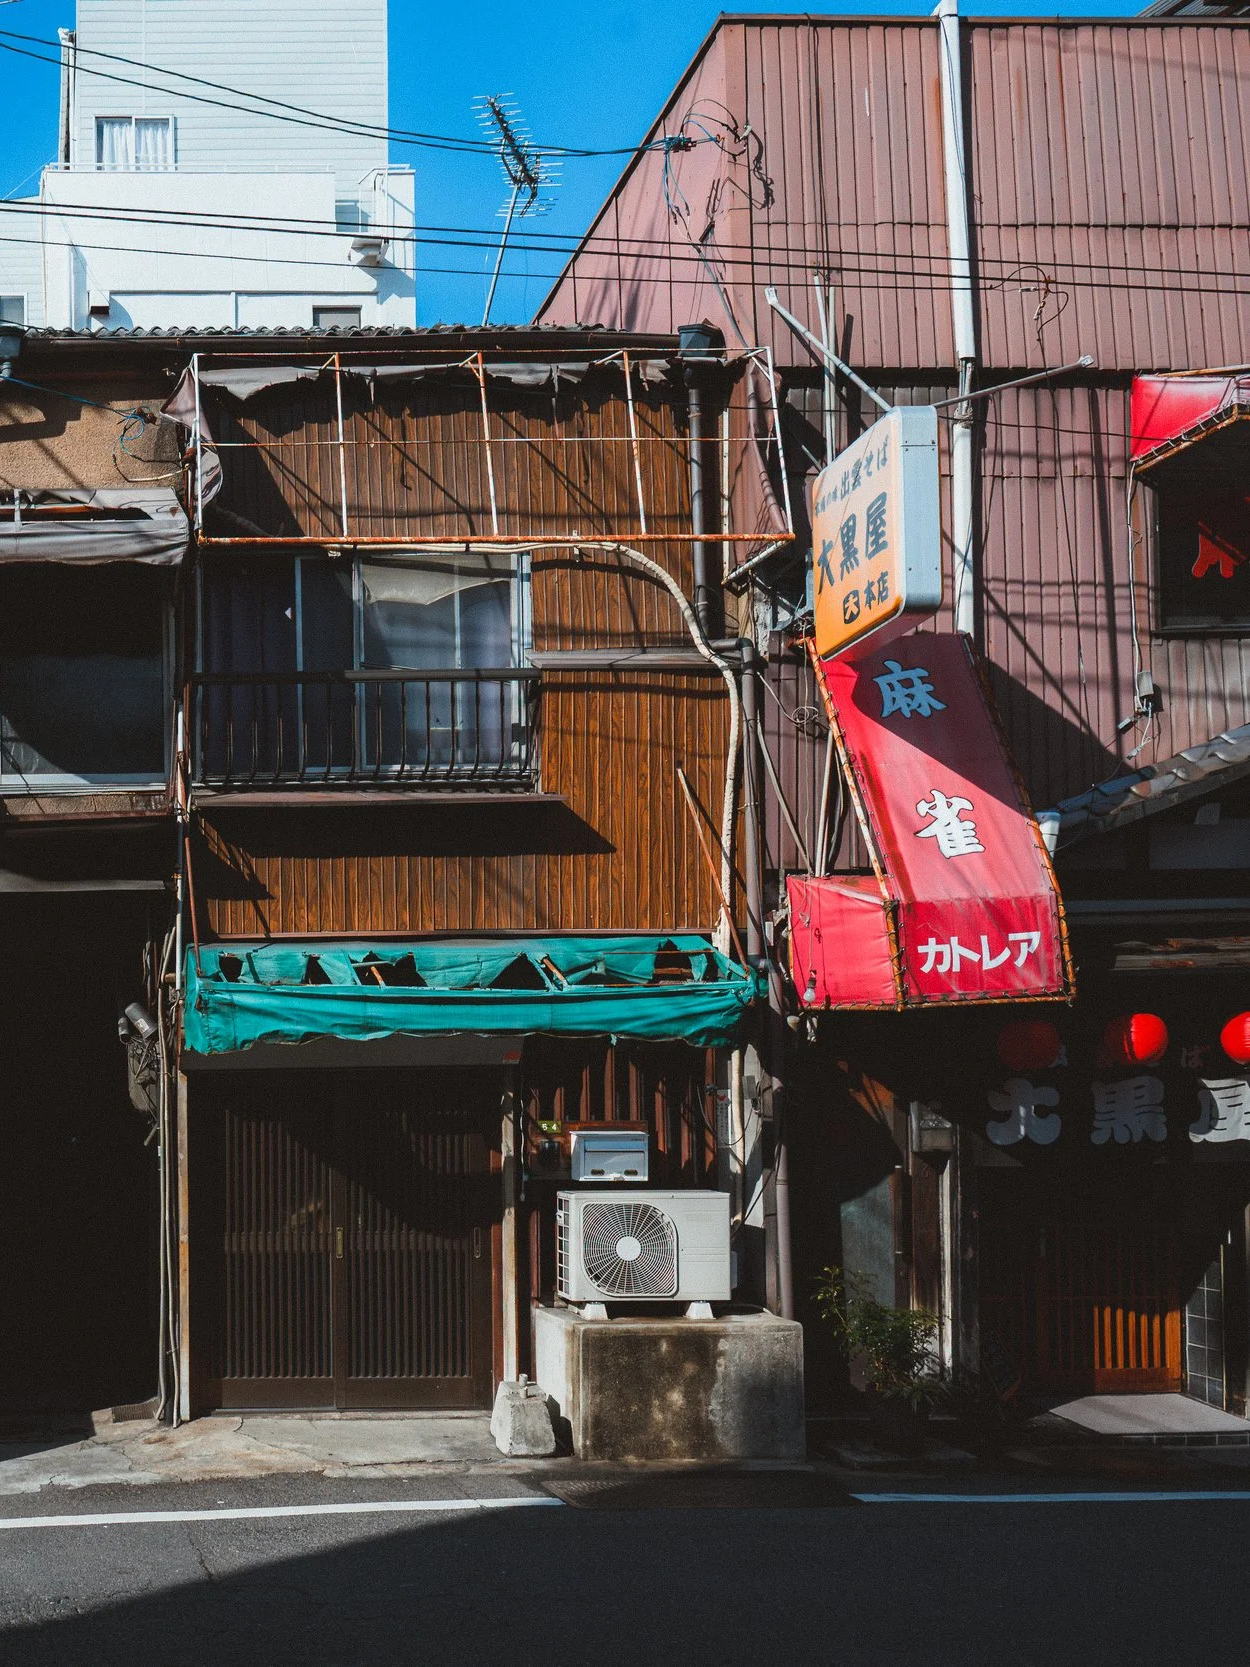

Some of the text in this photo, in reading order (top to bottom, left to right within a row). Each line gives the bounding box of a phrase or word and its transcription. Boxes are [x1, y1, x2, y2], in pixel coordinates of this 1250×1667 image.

[817, 491, 889, 595] 大黒屋
[864, 571, 889, 611] 本店
[872, 660, 986, 859] 麻雀
[917, 930, 1041, 974] カトレア
